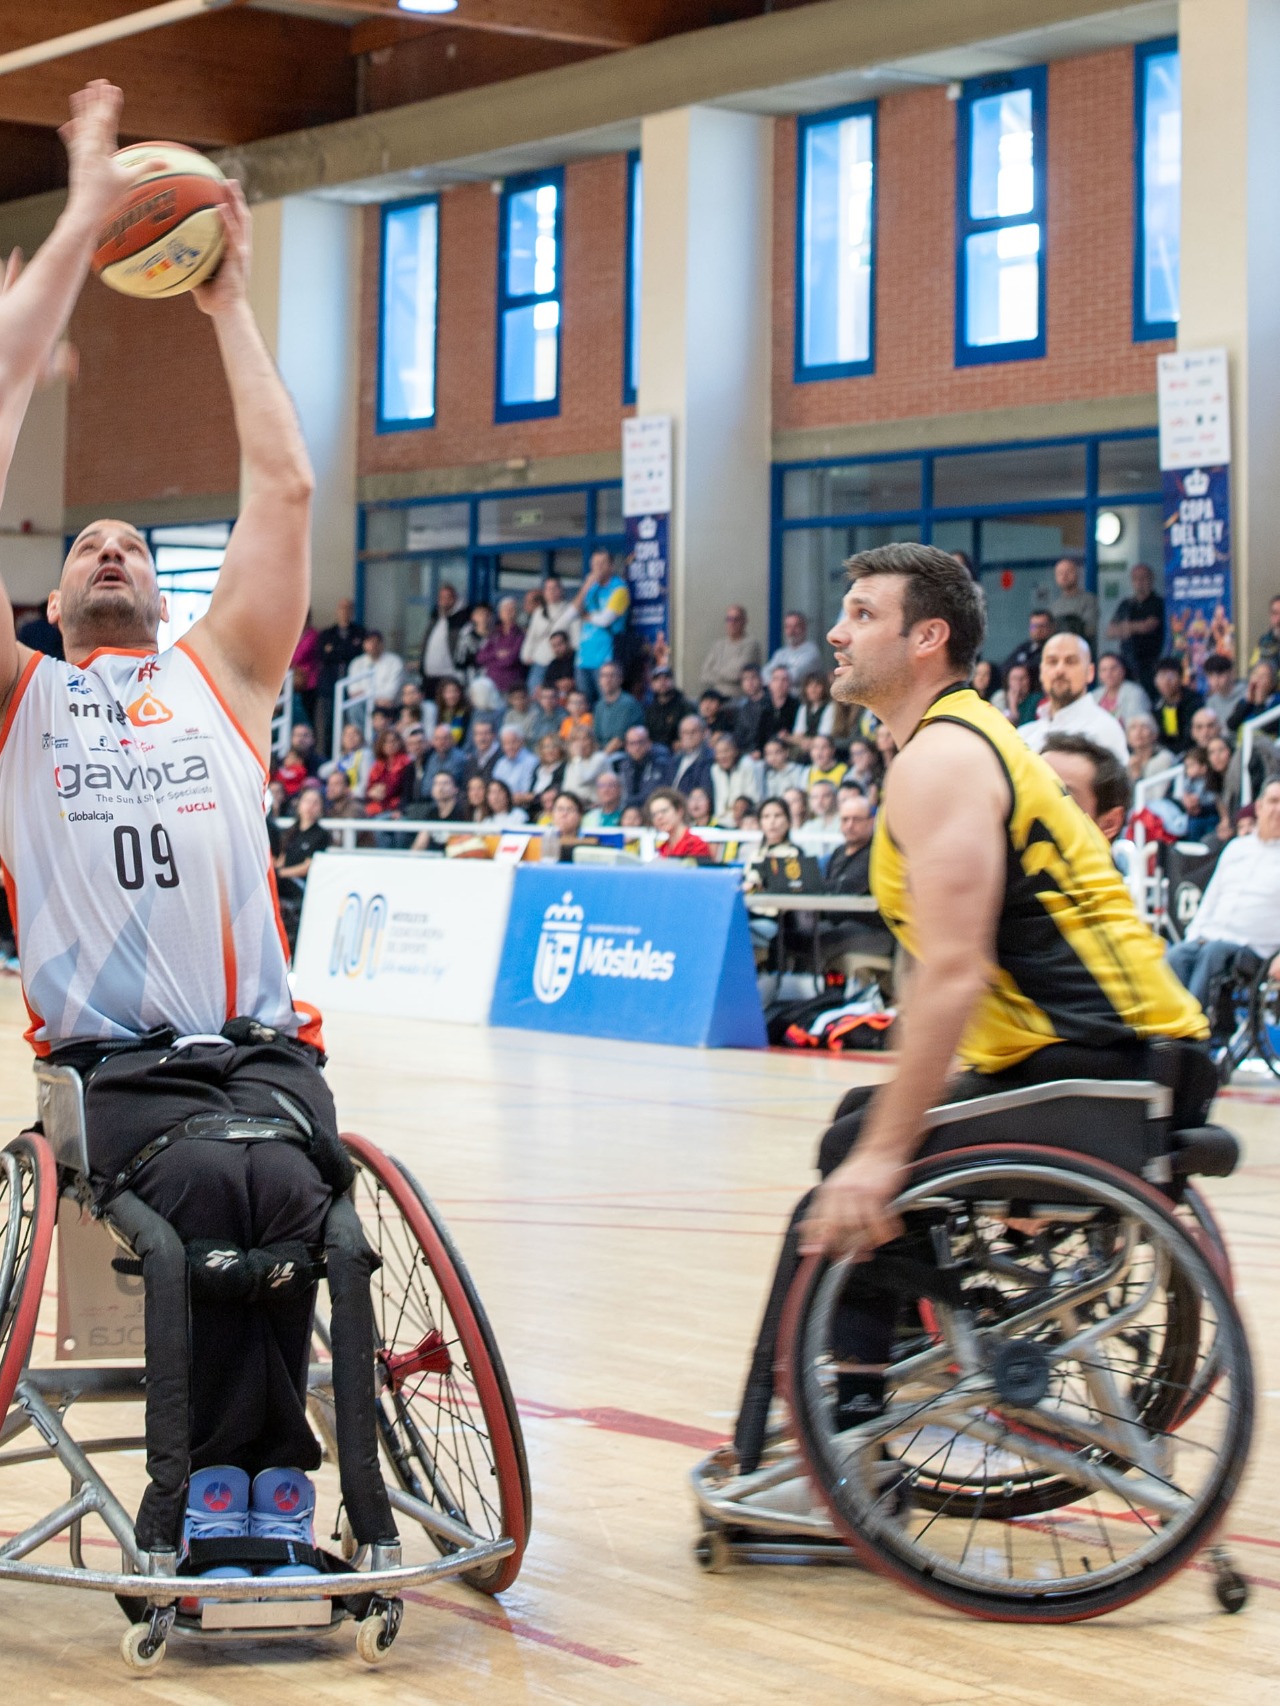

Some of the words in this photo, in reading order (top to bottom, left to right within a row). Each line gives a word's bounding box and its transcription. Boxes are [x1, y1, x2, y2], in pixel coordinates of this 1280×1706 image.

[55, 755, 210, 799] gaviota
[96, 794, 114, 803] The
[116, 795, 134, 804] Sun
[185, 801, 217, 813] UCLM
[68, 811, 114, 823] Globalcaja
[113, 823, 180, 890] 09
[578, 936, 676, 982] Móstoles
